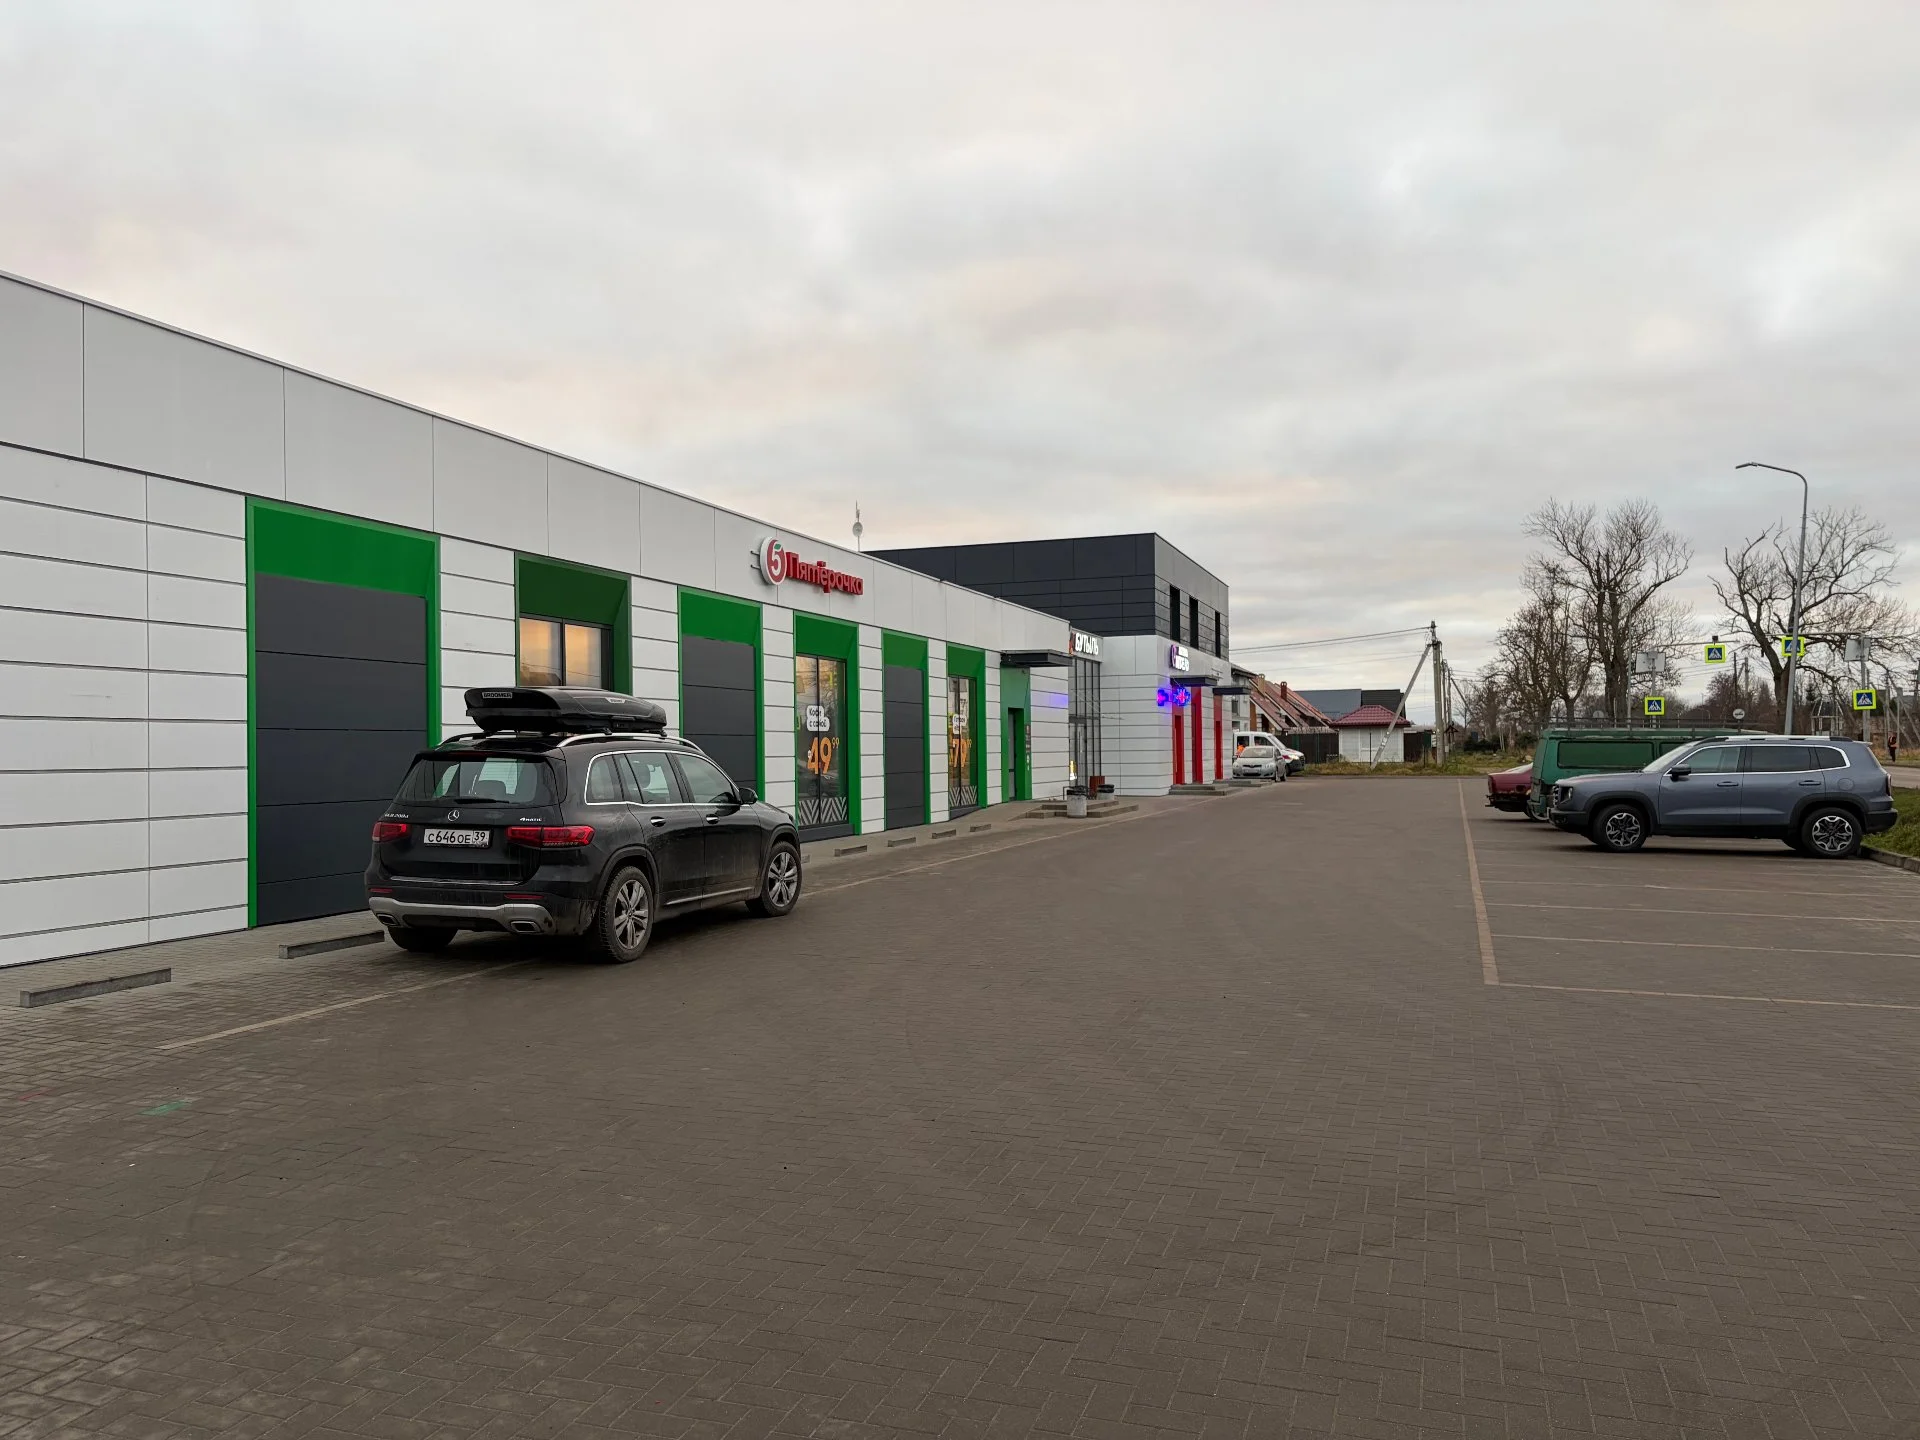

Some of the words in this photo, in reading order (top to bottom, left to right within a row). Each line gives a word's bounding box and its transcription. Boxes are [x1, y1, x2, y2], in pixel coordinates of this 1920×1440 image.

[786, 552, 863, 596] Пятёрочка
[808, 737, 832, 774] 49
[474, 831, 486, 841] 39
